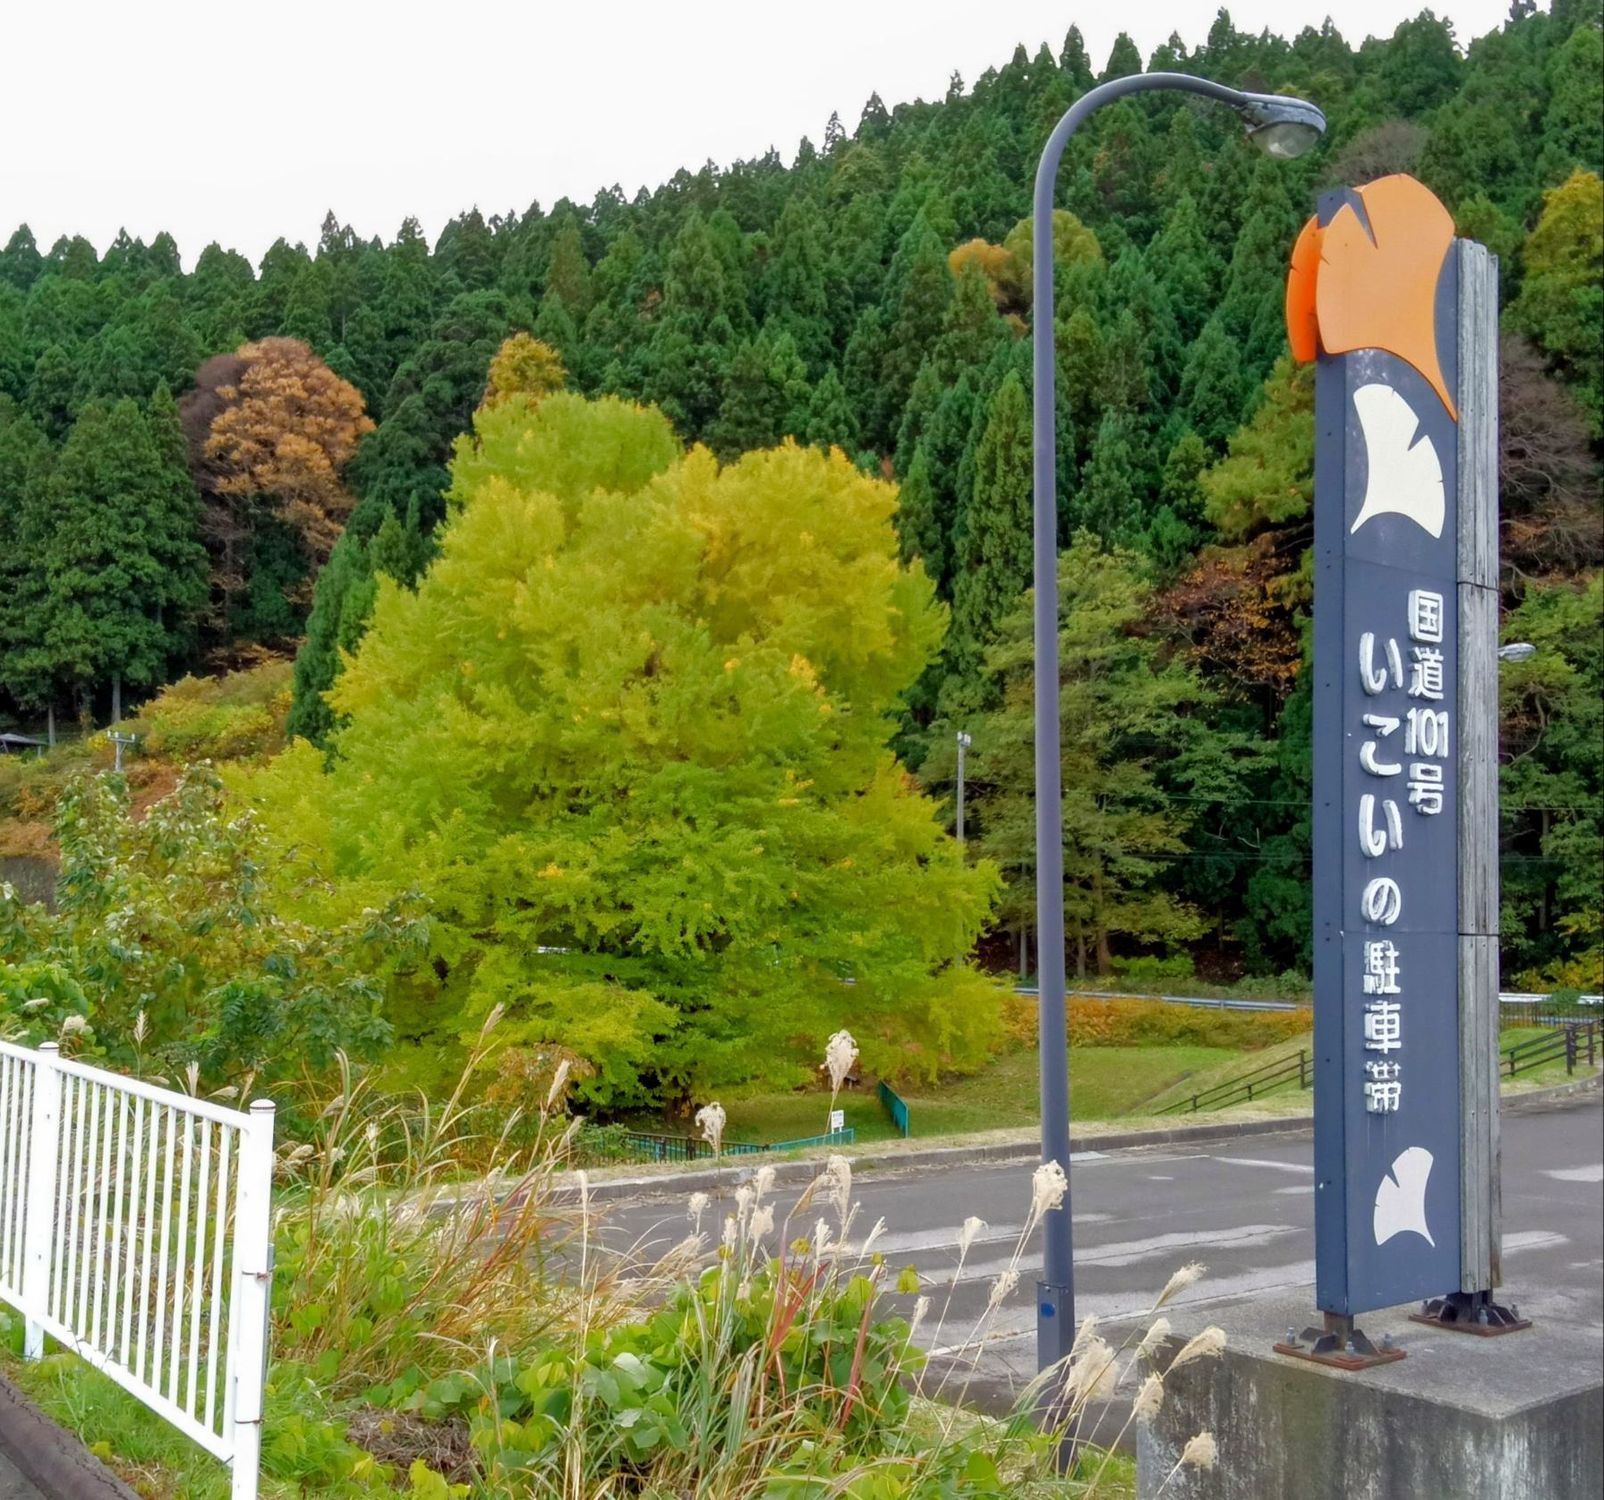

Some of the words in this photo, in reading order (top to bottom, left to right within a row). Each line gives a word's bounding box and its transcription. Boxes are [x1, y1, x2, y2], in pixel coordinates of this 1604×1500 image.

[1358, 632, 1403, 1114] いこいの駐車帯
[1405, 589, 1449, 815] 国道101号
